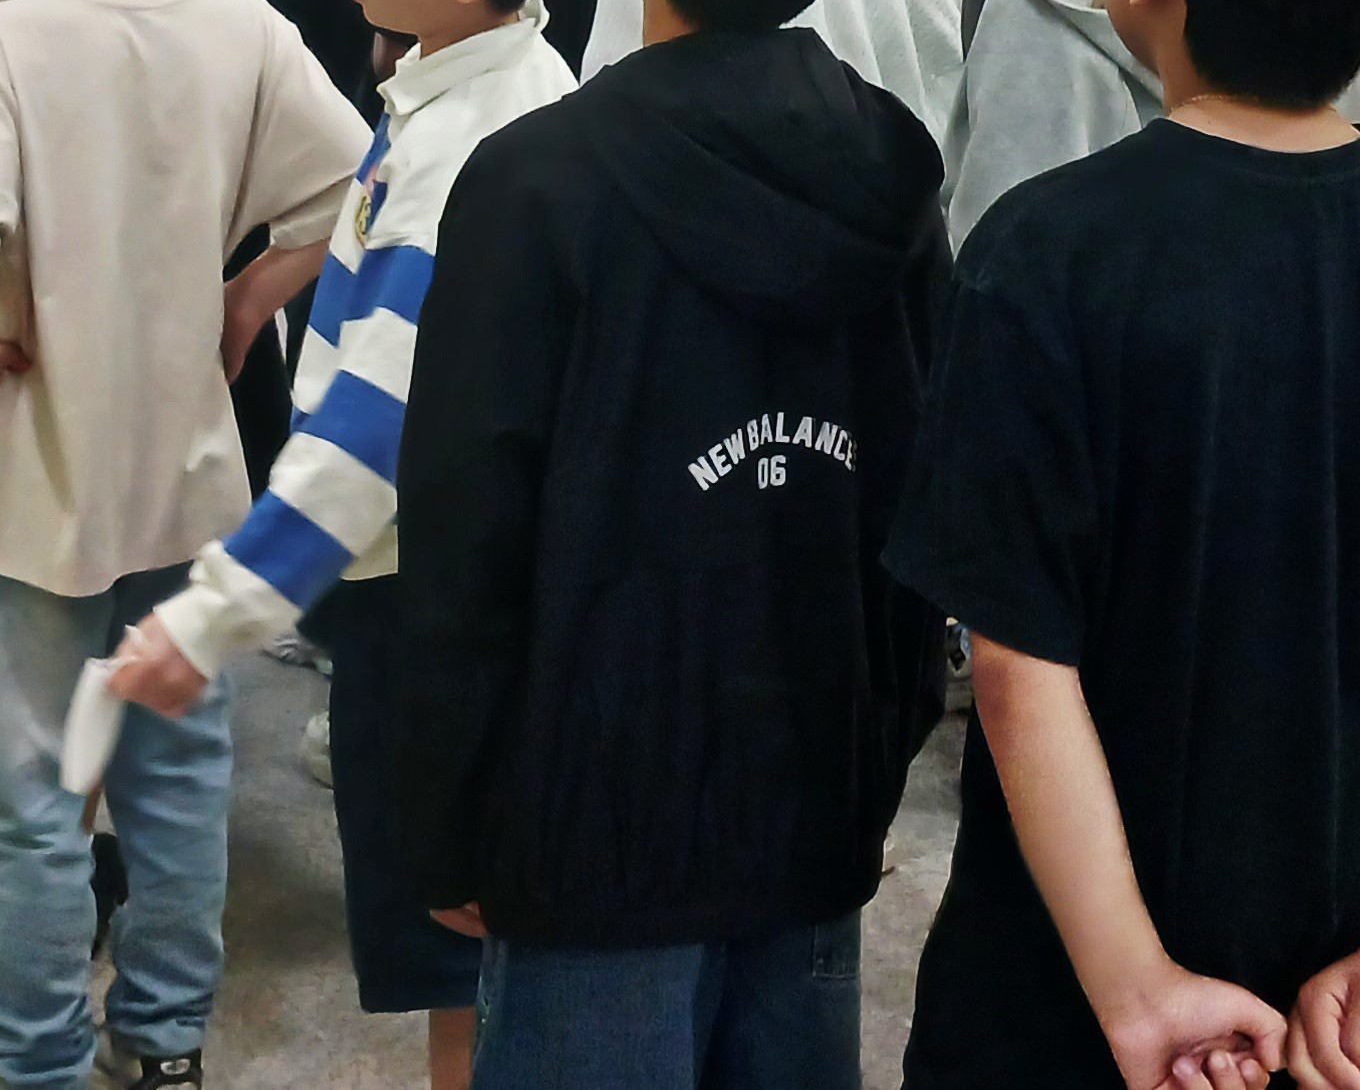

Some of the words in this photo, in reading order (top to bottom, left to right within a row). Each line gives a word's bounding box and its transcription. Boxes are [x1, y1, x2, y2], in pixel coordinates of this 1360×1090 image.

[687, 428, 746, 491] NEW
[746, 411, 858, 472] BALANCE
[757, 454, 787, 490] 06
